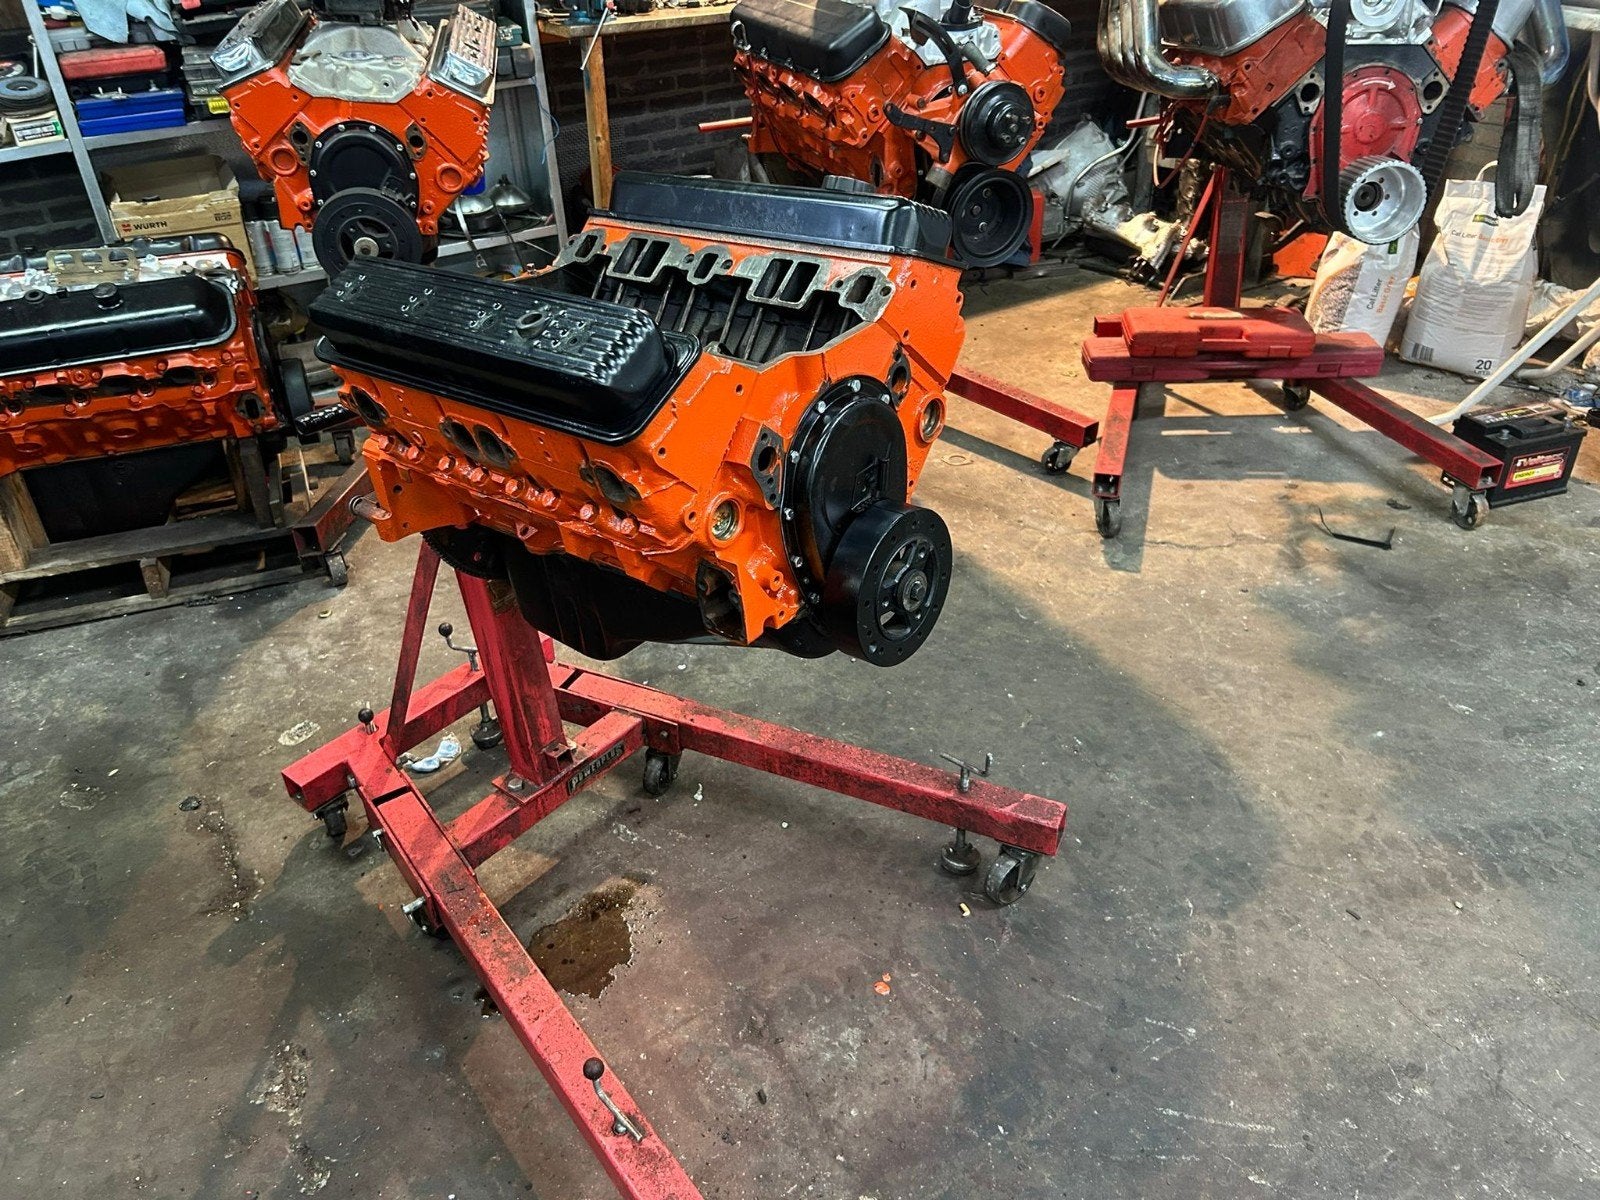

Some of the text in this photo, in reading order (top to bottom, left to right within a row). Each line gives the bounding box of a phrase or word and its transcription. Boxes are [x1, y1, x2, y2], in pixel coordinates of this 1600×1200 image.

[1366, 278, 1382, 310] Cat Litter
[1475, 359, 1492, 371] 20
